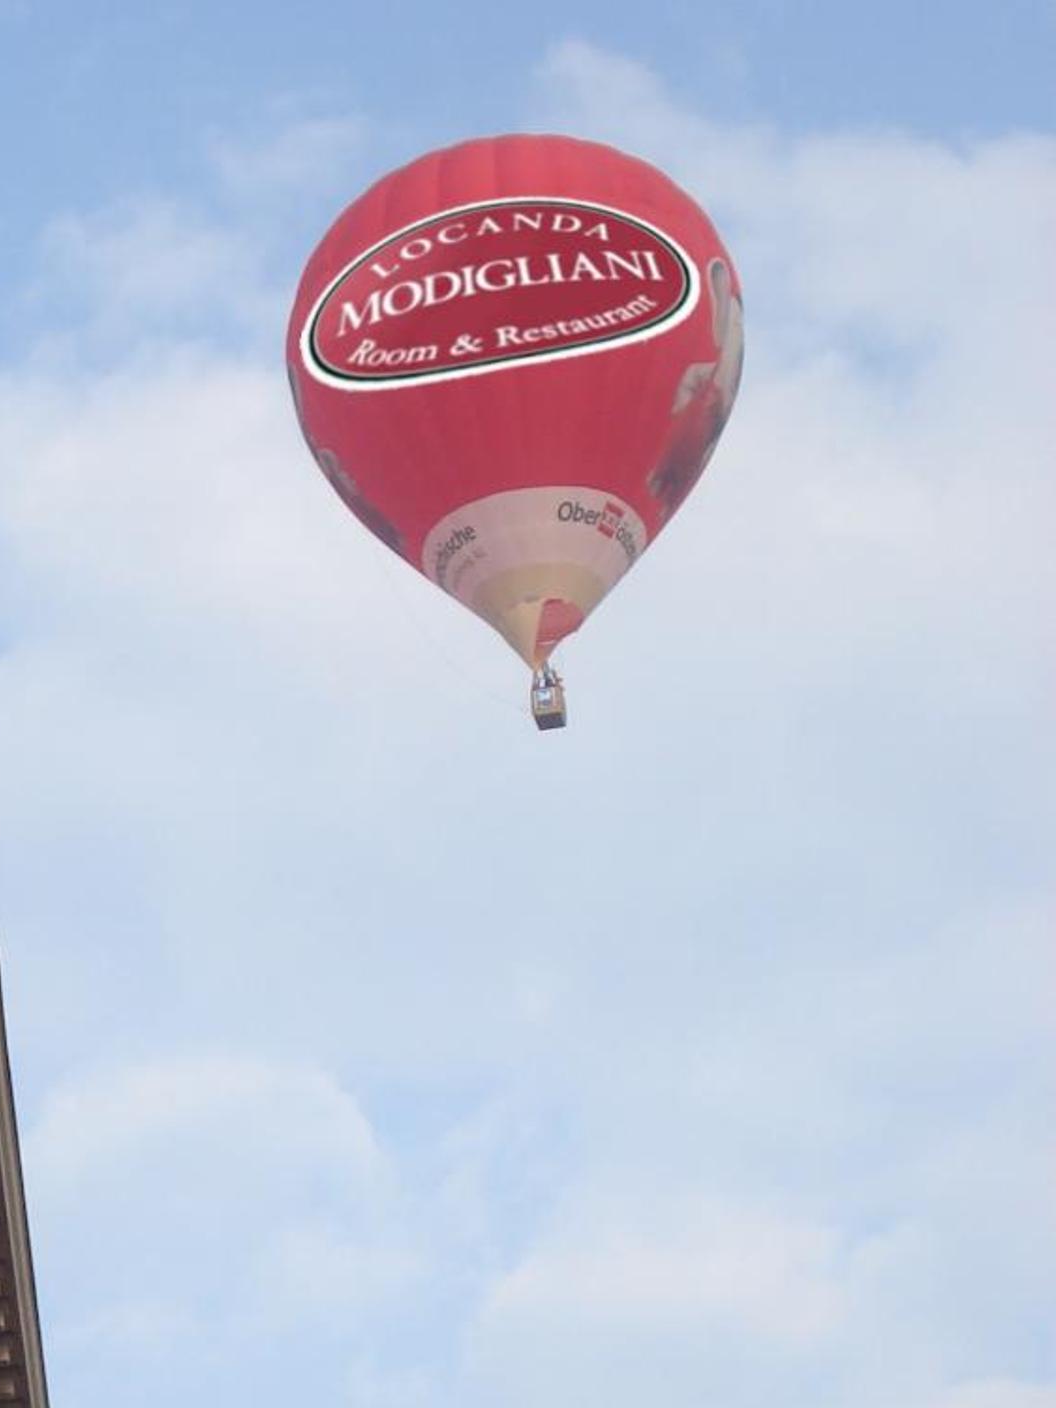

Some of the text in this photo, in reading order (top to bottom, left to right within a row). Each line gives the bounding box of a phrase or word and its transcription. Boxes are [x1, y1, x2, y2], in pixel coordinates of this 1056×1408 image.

[371, 212, 612, 279] LOCANDA
[336, 250, 664, 337] MODIGLIANI
[348, 293, 658, 367] Room & Restaurant
